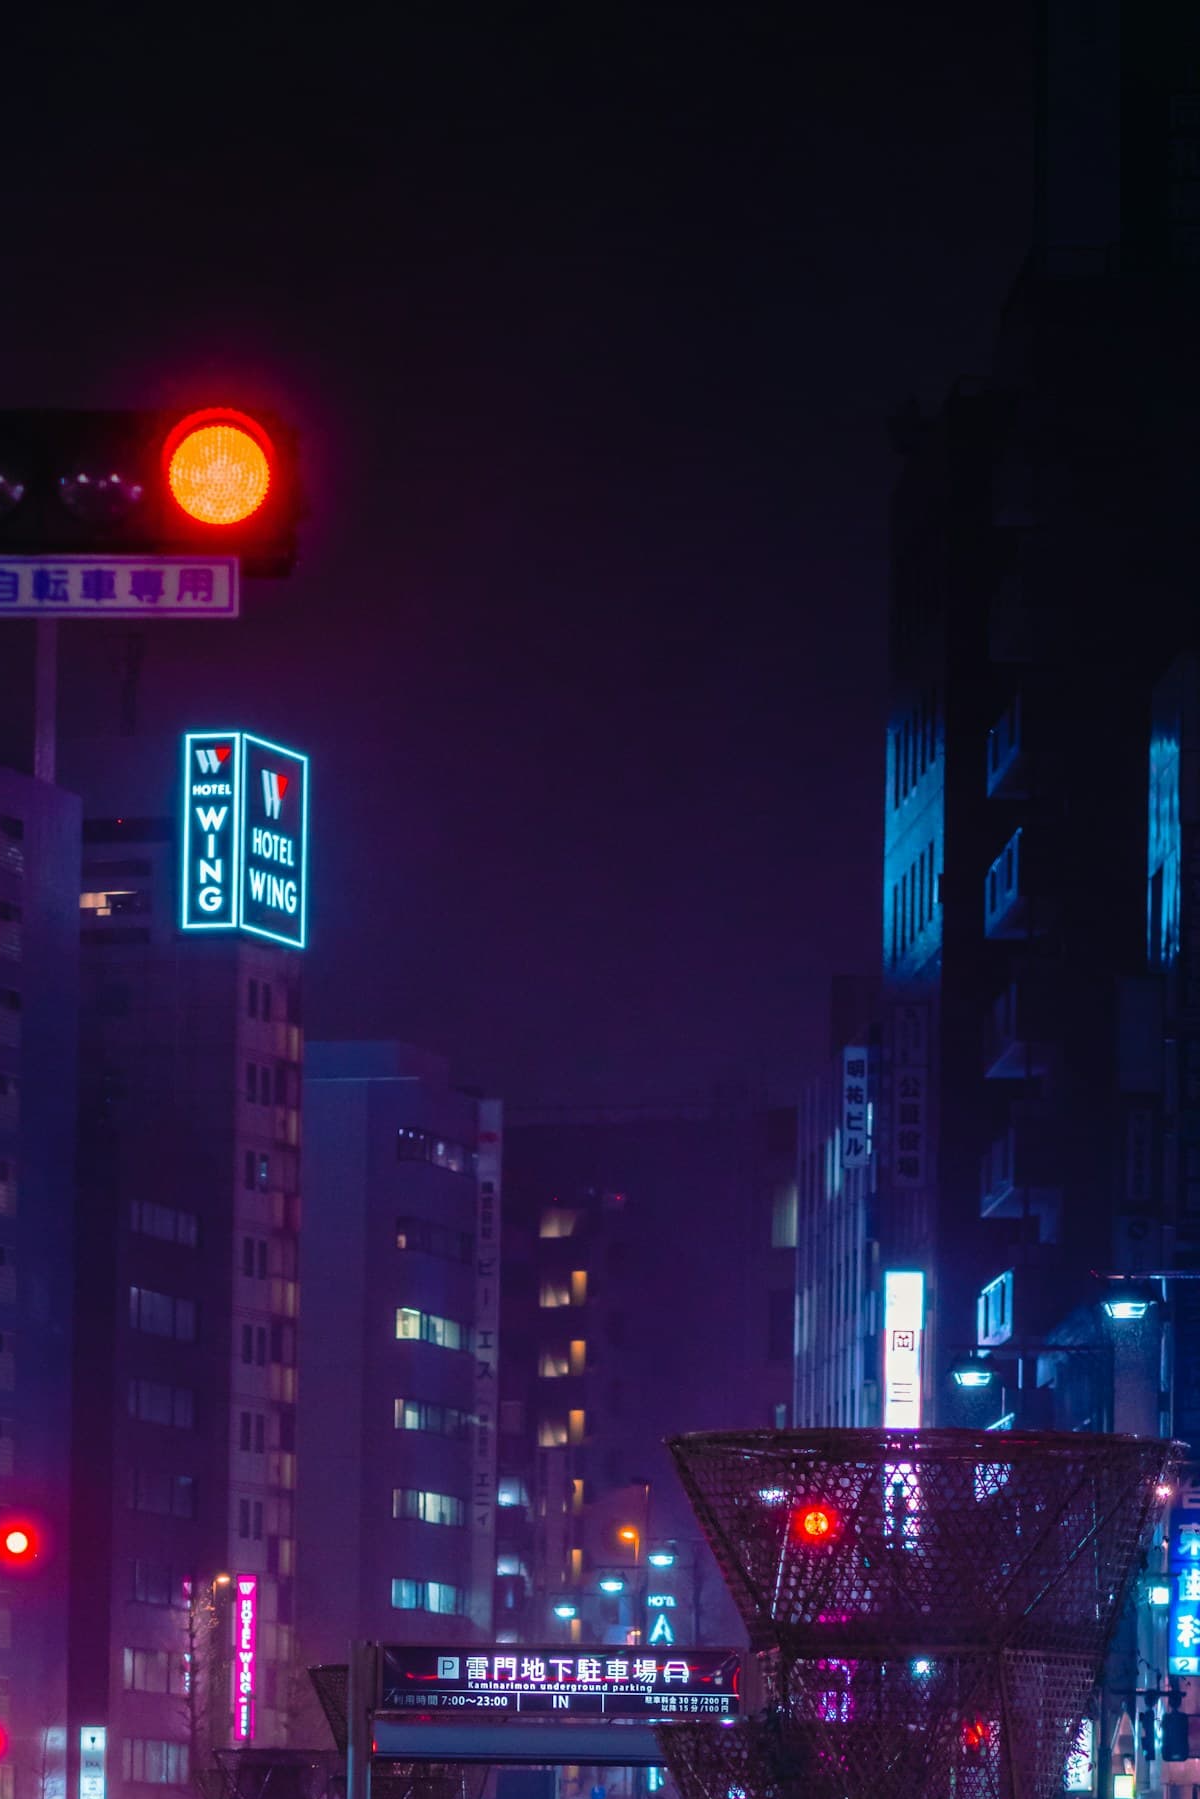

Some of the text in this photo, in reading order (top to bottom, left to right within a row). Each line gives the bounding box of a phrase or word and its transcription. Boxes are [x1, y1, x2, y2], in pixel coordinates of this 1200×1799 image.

[193, 784, 232, 795] HOTEL
[196, 806, 227, 912] WING
[252, 828, 294, 867] HOTEL
[249, 867, 297, 914] WING
[240, 1599, 253, 1649] HOTEL
[239, 1652, 253, 1694] WING
[466, 1656, 658, 1684] 雷門地下駐車場
[468, 1681, 653, 1693] Kaminarimon underground parking
[552, 1696, 569, 1709] IN
